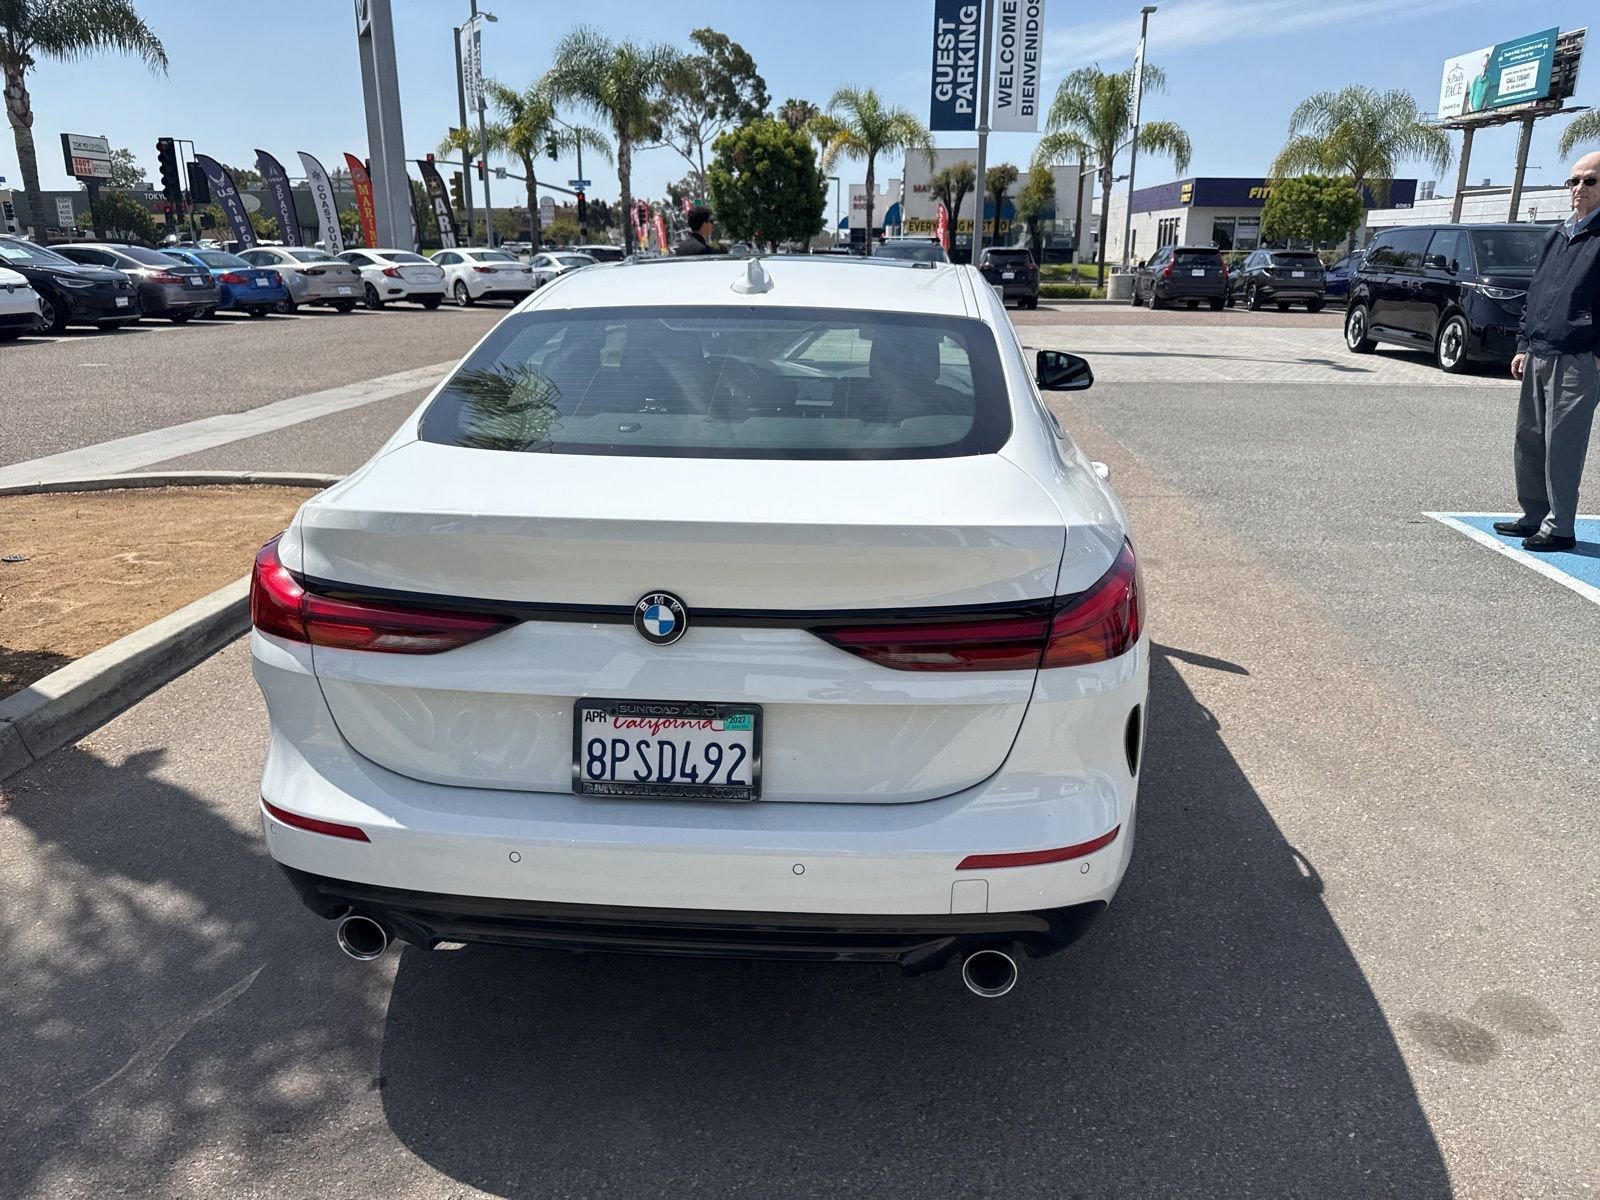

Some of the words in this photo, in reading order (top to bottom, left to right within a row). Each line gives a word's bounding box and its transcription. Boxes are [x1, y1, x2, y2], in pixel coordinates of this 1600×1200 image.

[935, 18, 956, 102] GUEST
[955, 5, 978, 114] PARKING
[998, 0, 1017, 109] WELCOME
[1021, 0, 1040, 116] BIENVENIDOS
[228, 199, 243, 224] AIR
[275, 184, 290, 225] SPACE
[317, 185, 332, 225] COAST
[240, 226, 254, 250] FOR
[286, 226, 296, 247] FOR
[435, 198, 457, 249] ARM
[327, 226, 340, 256] GUAR
[639, 595, 681, 613] BMW
[584, 710, 607, 723] APR
[619, 704, 680, 716] SUNROAD
[728, 716, 747, 725] 2027
[613, 716, 725, 736] California
[586, 737, 748, 786] 8PSD492
